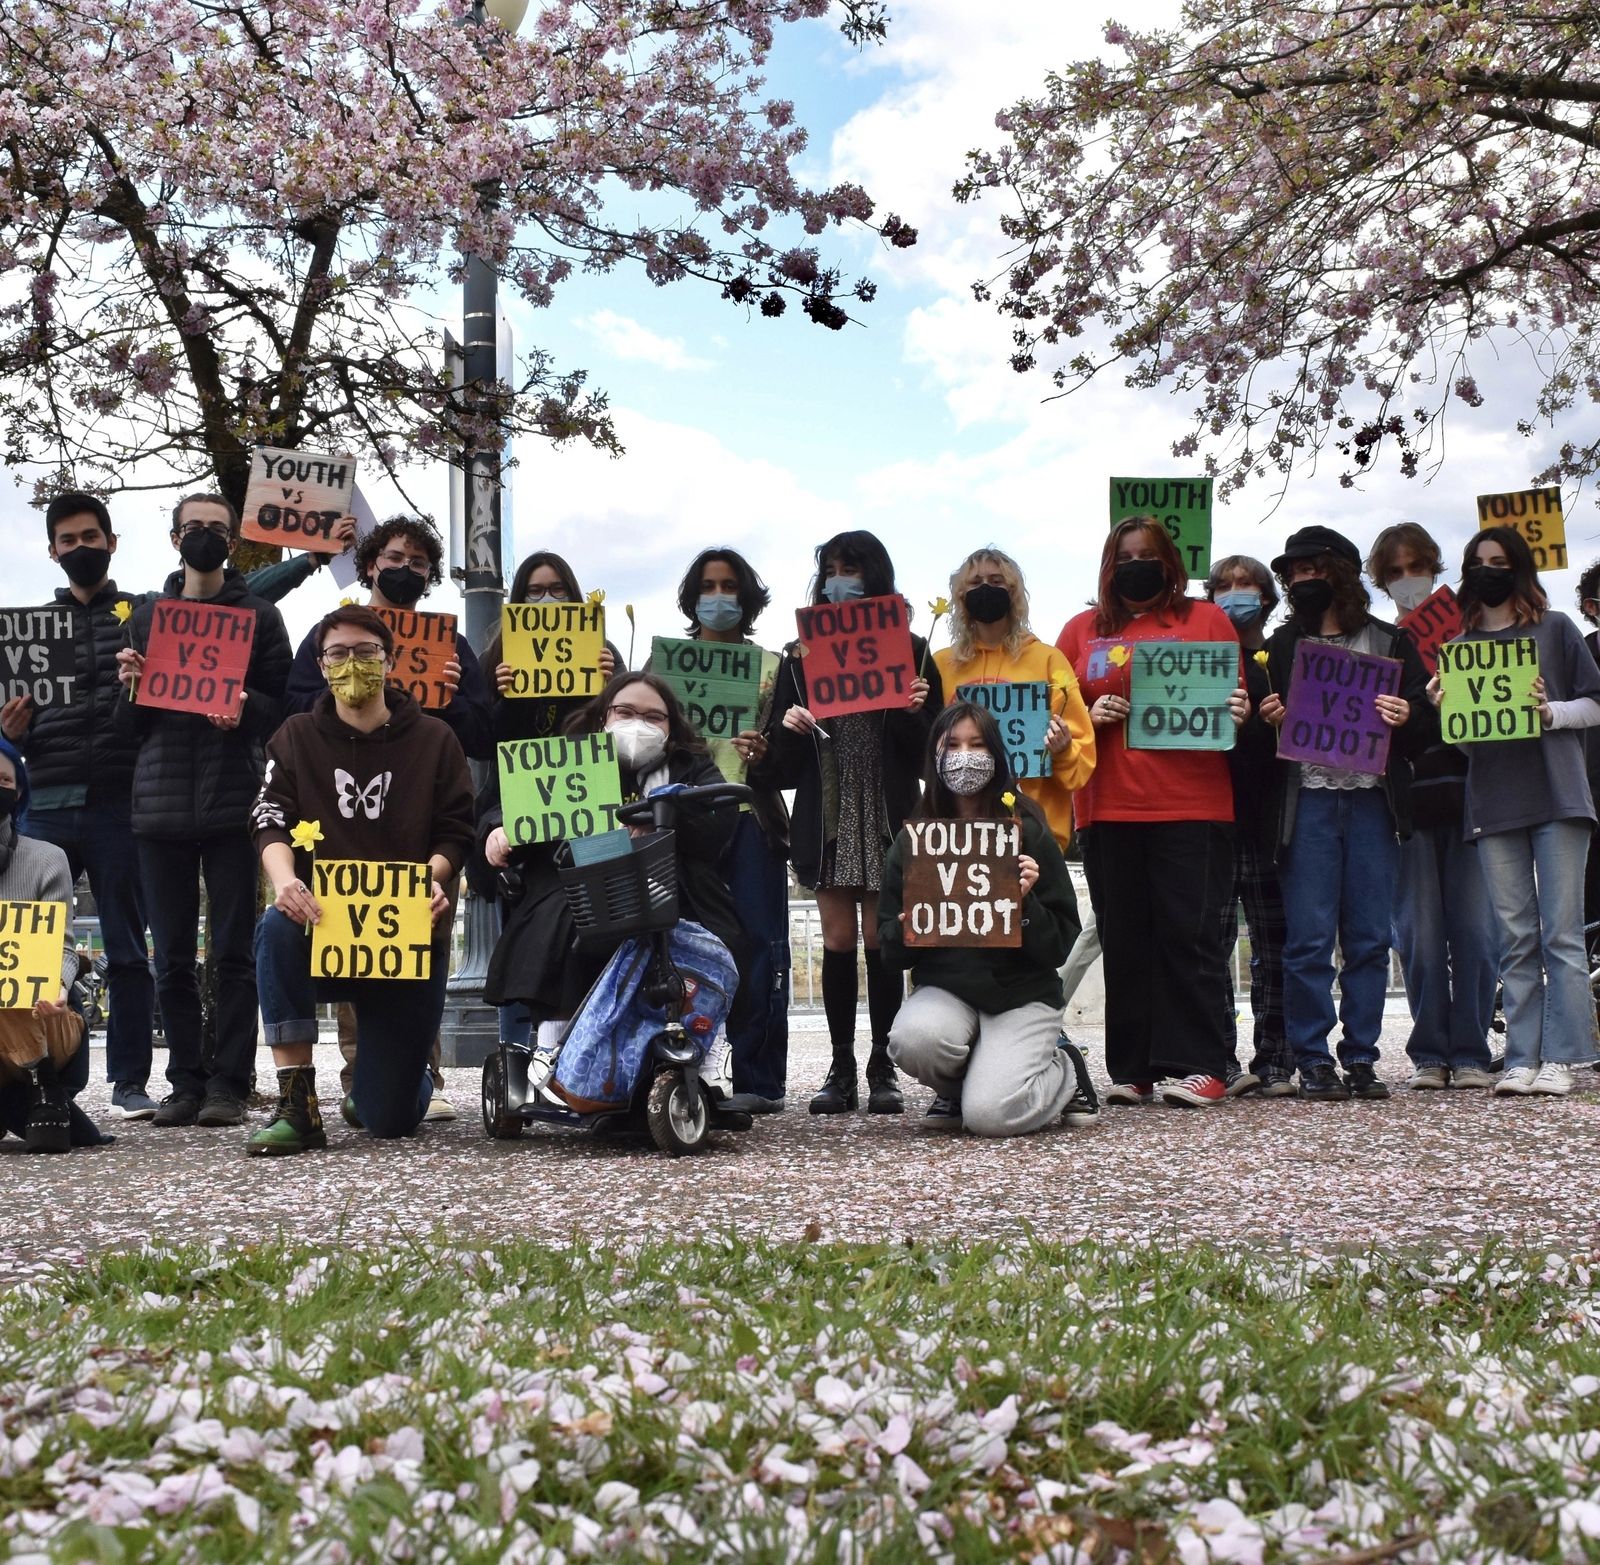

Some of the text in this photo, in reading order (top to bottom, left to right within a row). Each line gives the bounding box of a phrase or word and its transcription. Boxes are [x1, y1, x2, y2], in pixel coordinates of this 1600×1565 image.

[262, 455, 346, 489] YOUTH
[1116, 481, 1208, 510] YOUTH
[1477, 486, 1562, 521] YOUTH
[257, 504, 342, 540] ODOT
[1152, 514, 1181, 540] S
[0, 611, 73, 641] OUTH
[157, 606, 252, 643] YOUTH
[373, 607, 458, 643] OUTH
[506, 605, 598, 632] YOUTH
[799, 601, 900, 641] YOUTH
[5, 644, 49, 675] VS
[178, 642, 220, 671] VS
[532, 637, 573, 663] VS
[660, 642, 751, 679] YOUTH
[831, 637, 878, 669] VS
[1139, 647, 1231, 679] YOUTH
[1439, 638, 1536, 674] YOUTH
[148, 672, 241, 705] ODOT
[511, 667, 597, 694] ODOT
[813, 663, 906, 705] ODOT
[1301, 652, 1398, 694] YOUTH
[1467, 674, 1512, 705] VS
[0, 676, 76, 708] DOT
[1322, 690, 1364, 723] VS
[681, 702, 749, 738] DOT
[1142, 705, 1229, 740] ODOT
[1448, 705, 1536, 740] ODOT
[499, 732, 615, 774] YOUTH
[1291, 720, 1385, 760] ODOT
[535, 772, 588, 806] VS
[514, 803, 620, 844] ODOT
[906, 821, 1020, 857] YOUTH
[315, 863, 432, 898] YOUTH
[937, 862, 991, 896] VS
[348, 904, 400, 938] VS
[912, 898, 1018, 936] ODOT
[320, 944, 431, 978] ODOT
[0, 976, 49, 1008] OT
